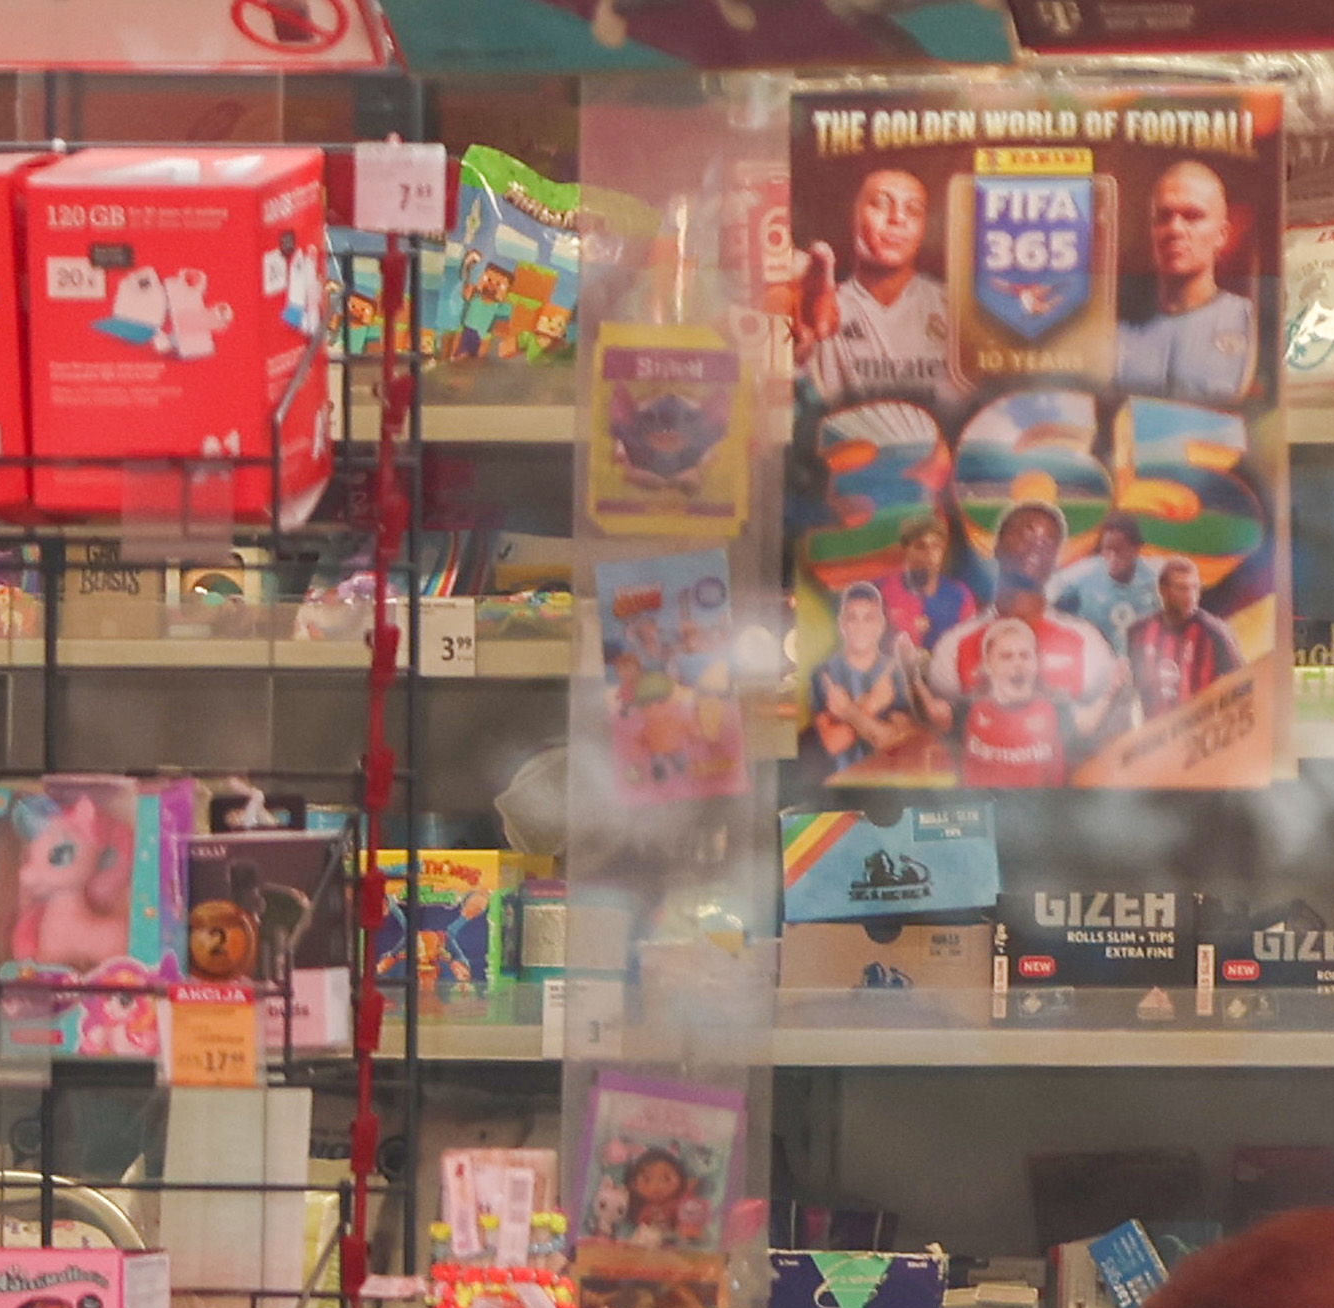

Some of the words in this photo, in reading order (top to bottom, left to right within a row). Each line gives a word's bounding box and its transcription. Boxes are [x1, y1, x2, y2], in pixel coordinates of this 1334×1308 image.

[814, 110, 867, 154] THE
[873, 111, 975, 148] GOLDEN
[984, 110, 1078, 141] WORLD
[1084, 110, 1116, 141] OF
[1125, 110, 1257, 154] FOOTBALL
[984, 187, 1079, 224] FIFA
[984, 230, 1079, 270] 365
[1035, 891, 1175, 927] GIZEH
[1067, 931, 1102, 944] ROLLS
[1106, 931, 1134, 944] SLIM
[1150, 931, 1176, 944] TIPS
[1105, 946, 1143, 960] EXTRA
[1148, 946, 1175, 960] FINE
[1022, 960, 1053, 974] NEW
[1226, 963, 1256, 978] NEW
[176, 985, 248, 1003] AKCIJA
